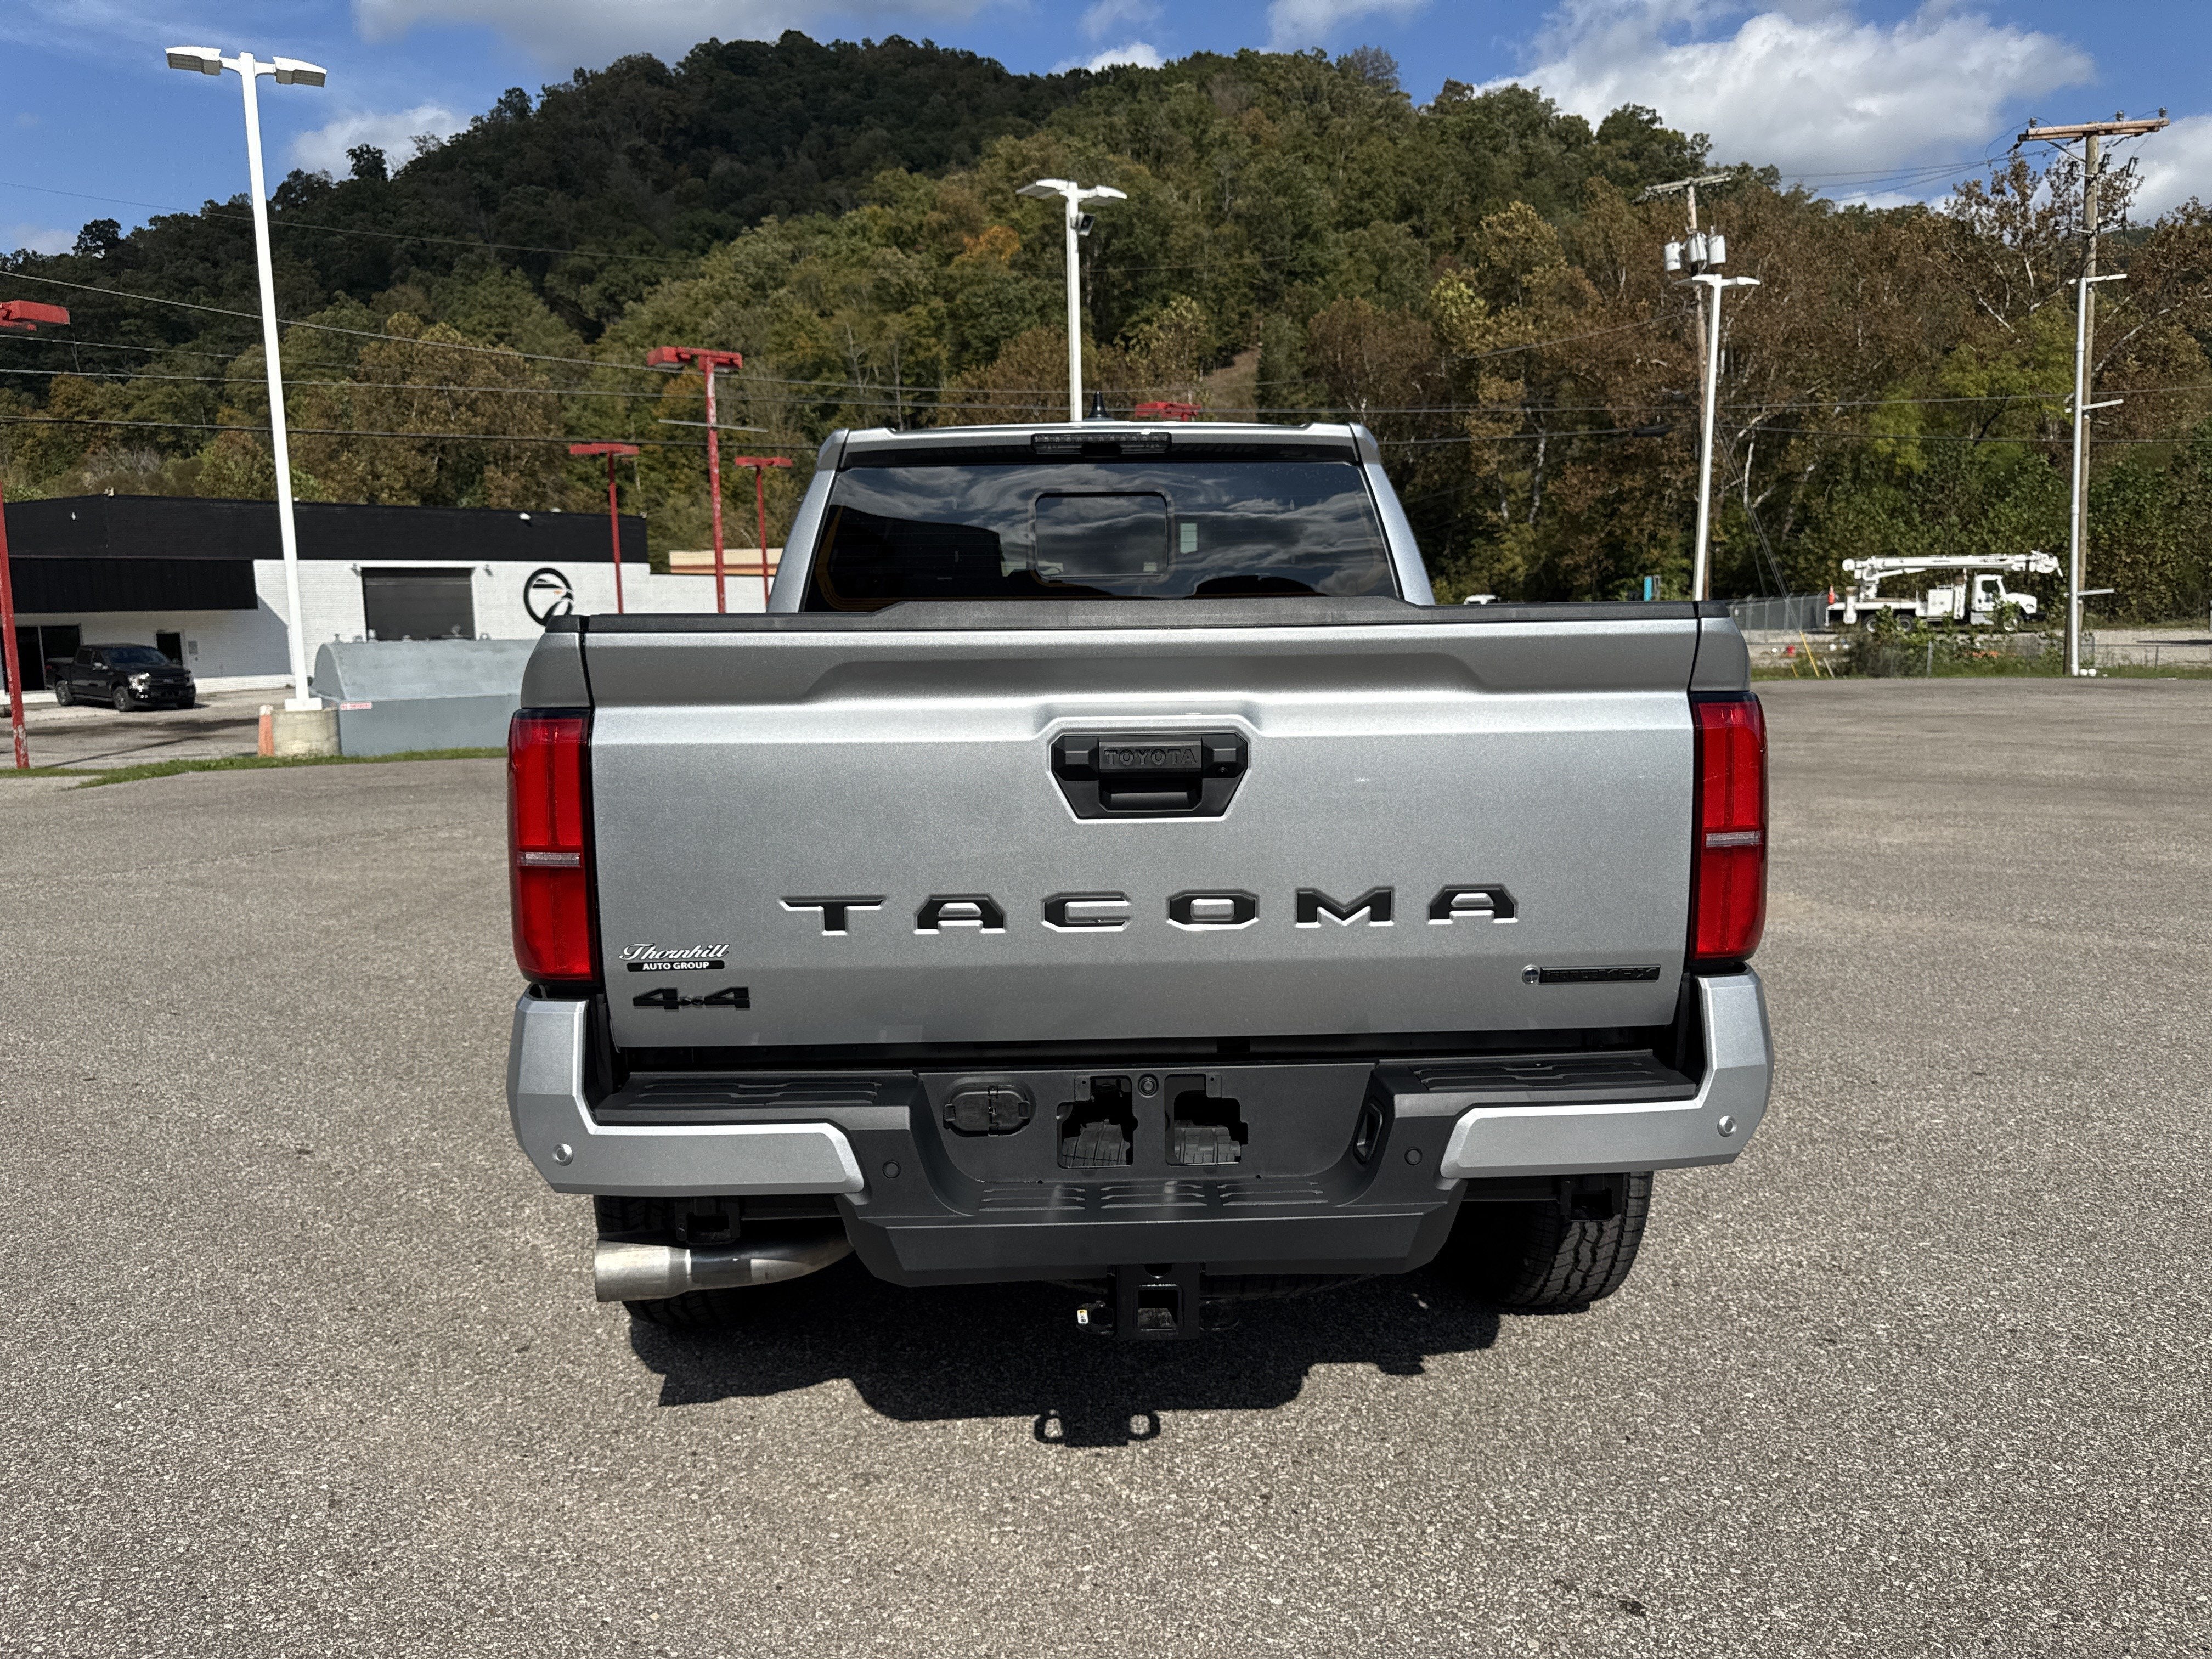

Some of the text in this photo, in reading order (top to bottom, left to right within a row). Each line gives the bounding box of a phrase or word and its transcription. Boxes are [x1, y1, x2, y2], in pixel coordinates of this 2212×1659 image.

[1104, 748, 1197, 766] TOYOTA
[779, 883, 1519, 936] TACOMA
[619, 943, 730, 961] Thornhill
[642, 961, 710, 971] AUTO GROUP
